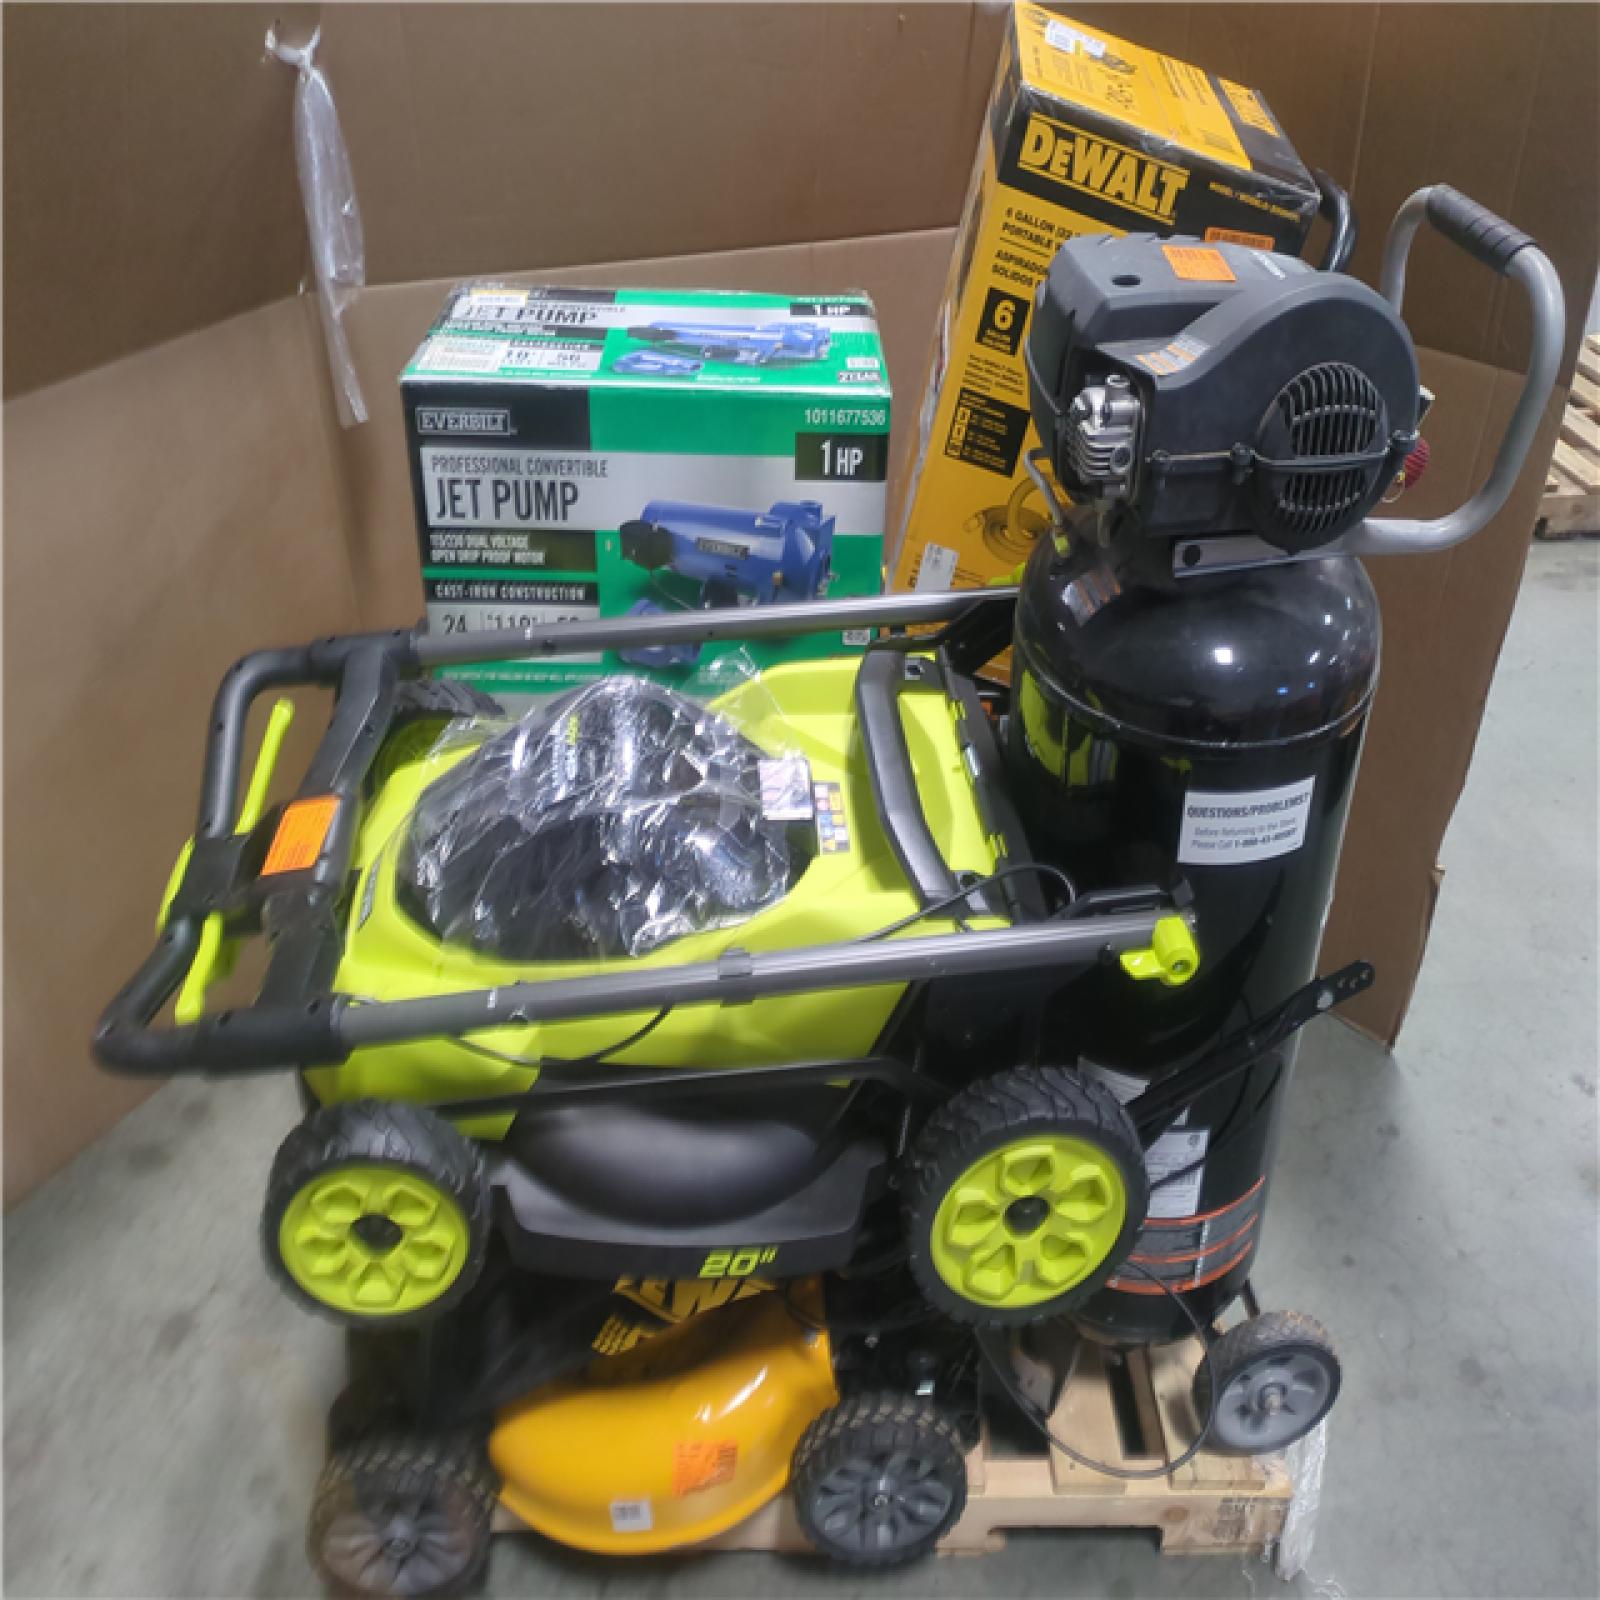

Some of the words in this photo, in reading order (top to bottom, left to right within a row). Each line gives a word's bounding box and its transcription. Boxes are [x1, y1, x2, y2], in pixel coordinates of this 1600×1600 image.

[1014, 210, 1055, 233] GALLON
[1002, 222, 1052, 250] PORTABLE
[515, 307, 597, 323] PUMP
[993, 299, 1016, 332] 6
[420, 411, 506, 432] EVERBILT
[432, 455, 523, 476] PROFESSIONAL
[527, 458, 609, 478] CONVERTIBLE
[821, 439, 831, 476] 1
[837, 447, 863, 476] HP
[437, 478, 480, 519] JET
[492, 479, 579, 521] PUMP
[490, 534, 529, 551] VOLTAGE
[431, 549, 456, 563] OPEN
[482, 551, 511, 564] PROOF
[435, 584, 498, 599] CAST-IRON
[500, 585, 586, 601] CONSTRUCTION
[443, 614, 466, 635] 24
[1186, 792, 1311, 819] QUESTIONS/PROBLEMS?
[1195, 826, 1218, 837] Before
[1221, 825, 1256, 838] Returning
[697, 1246, 779, 1278] 20"
